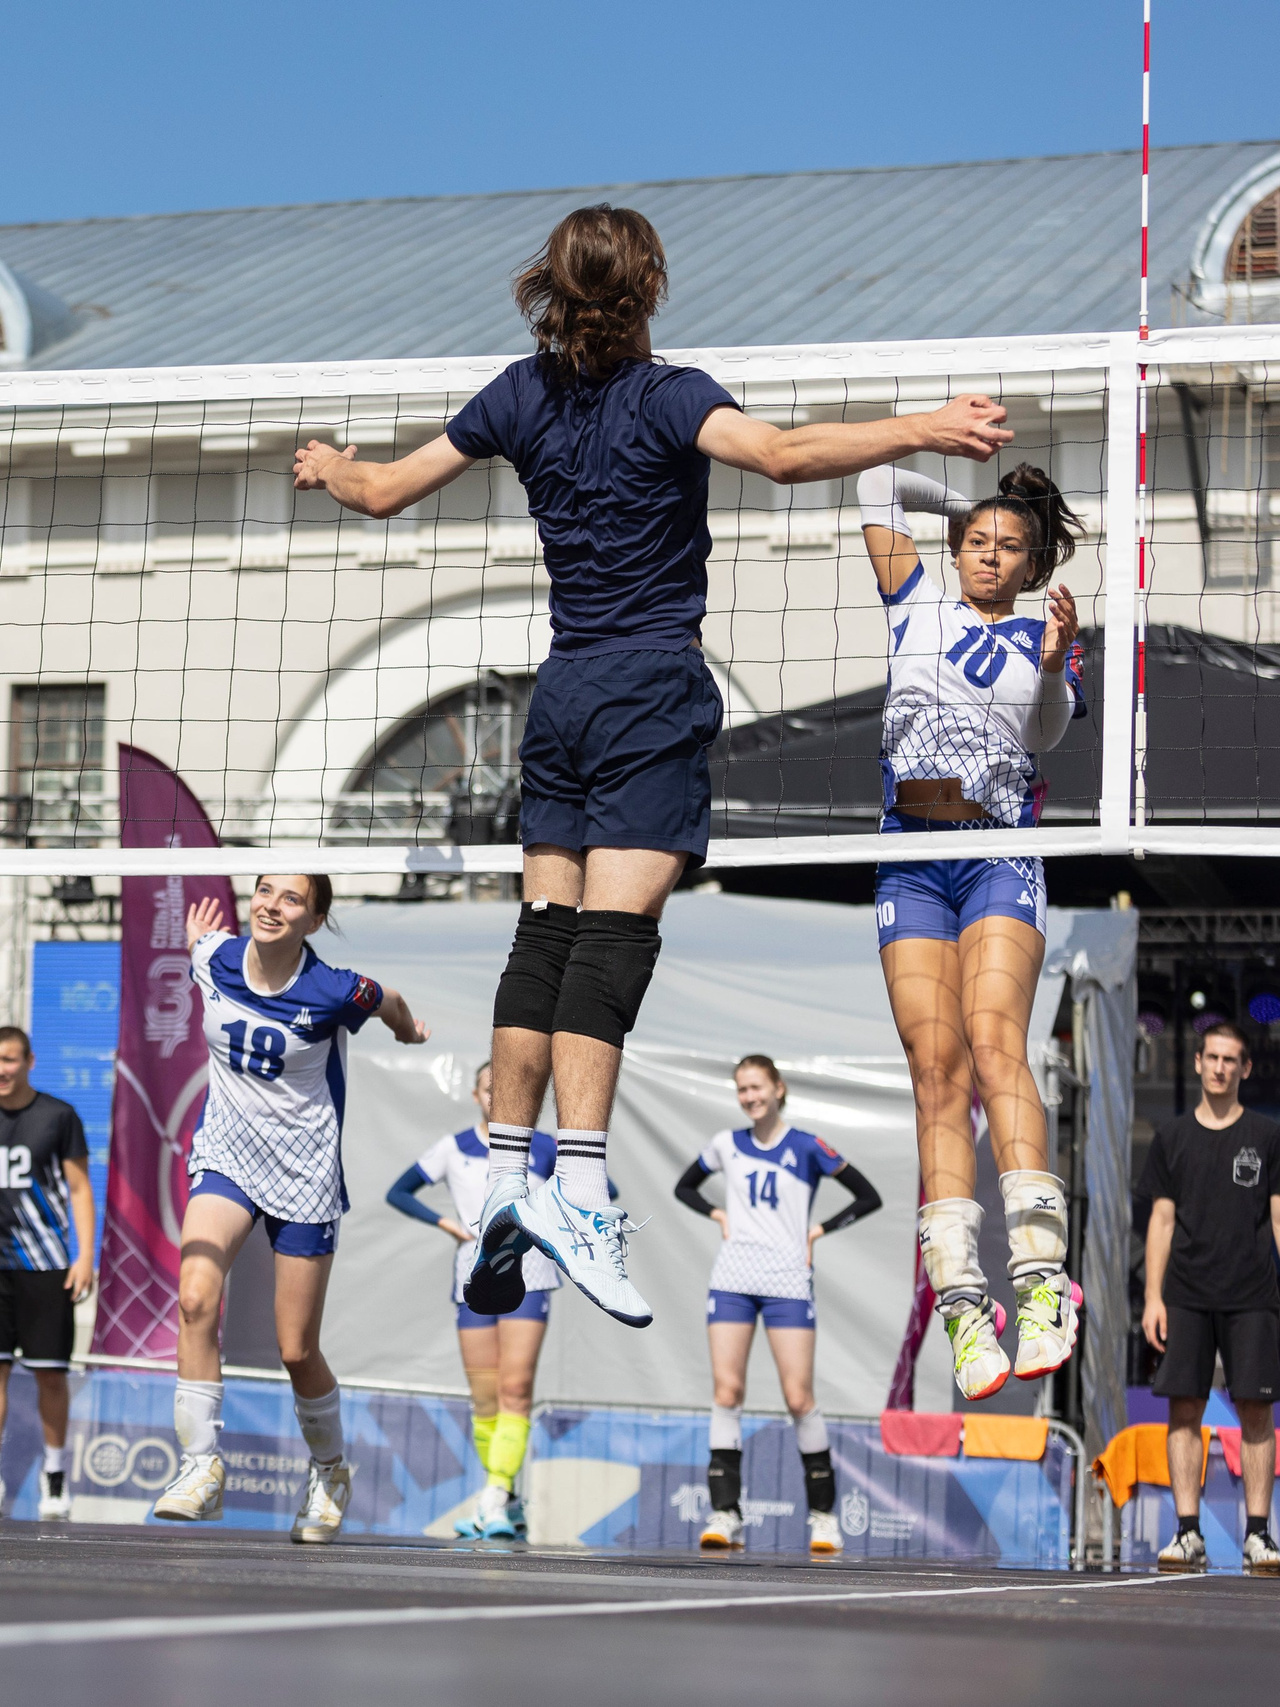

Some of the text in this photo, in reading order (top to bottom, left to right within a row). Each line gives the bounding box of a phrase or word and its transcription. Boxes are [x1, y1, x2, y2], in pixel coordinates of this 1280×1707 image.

[945, 625, 1008, 689] 10
[877, 901, 896, 929] 10
[221, 1019, 286, 1082] 18
[745, 1171, 779, 1210] 14
